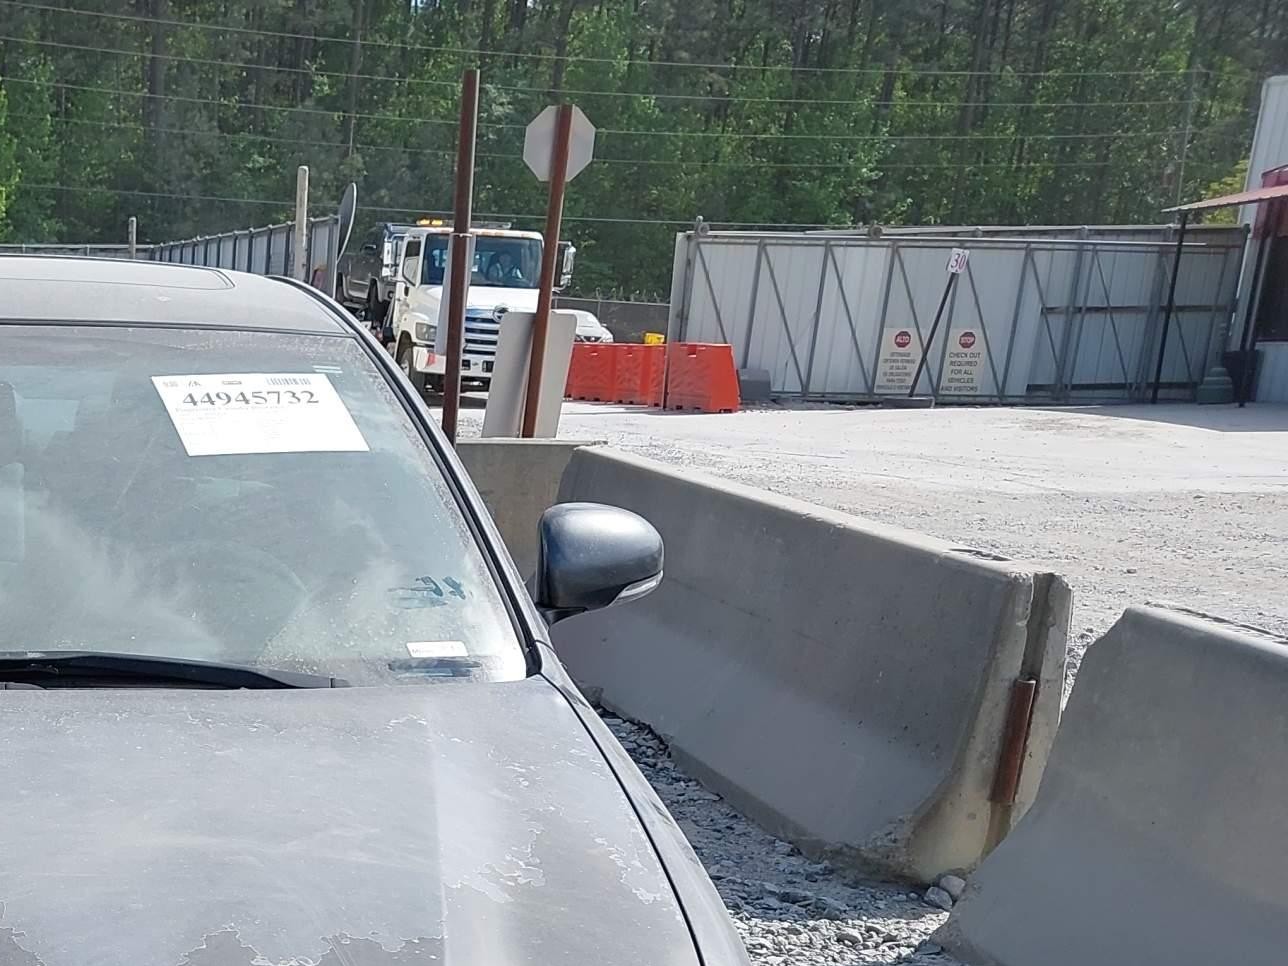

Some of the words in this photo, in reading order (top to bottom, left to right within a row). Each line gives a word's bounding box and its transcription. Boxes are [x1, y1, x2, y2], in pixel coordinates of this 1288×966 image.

[951, 253, 966, 270] 30
[949, 351, 968, 359] CHECK
[969, 351, 981, 359] OUT
[182, 390, 320, 407] 44945732
